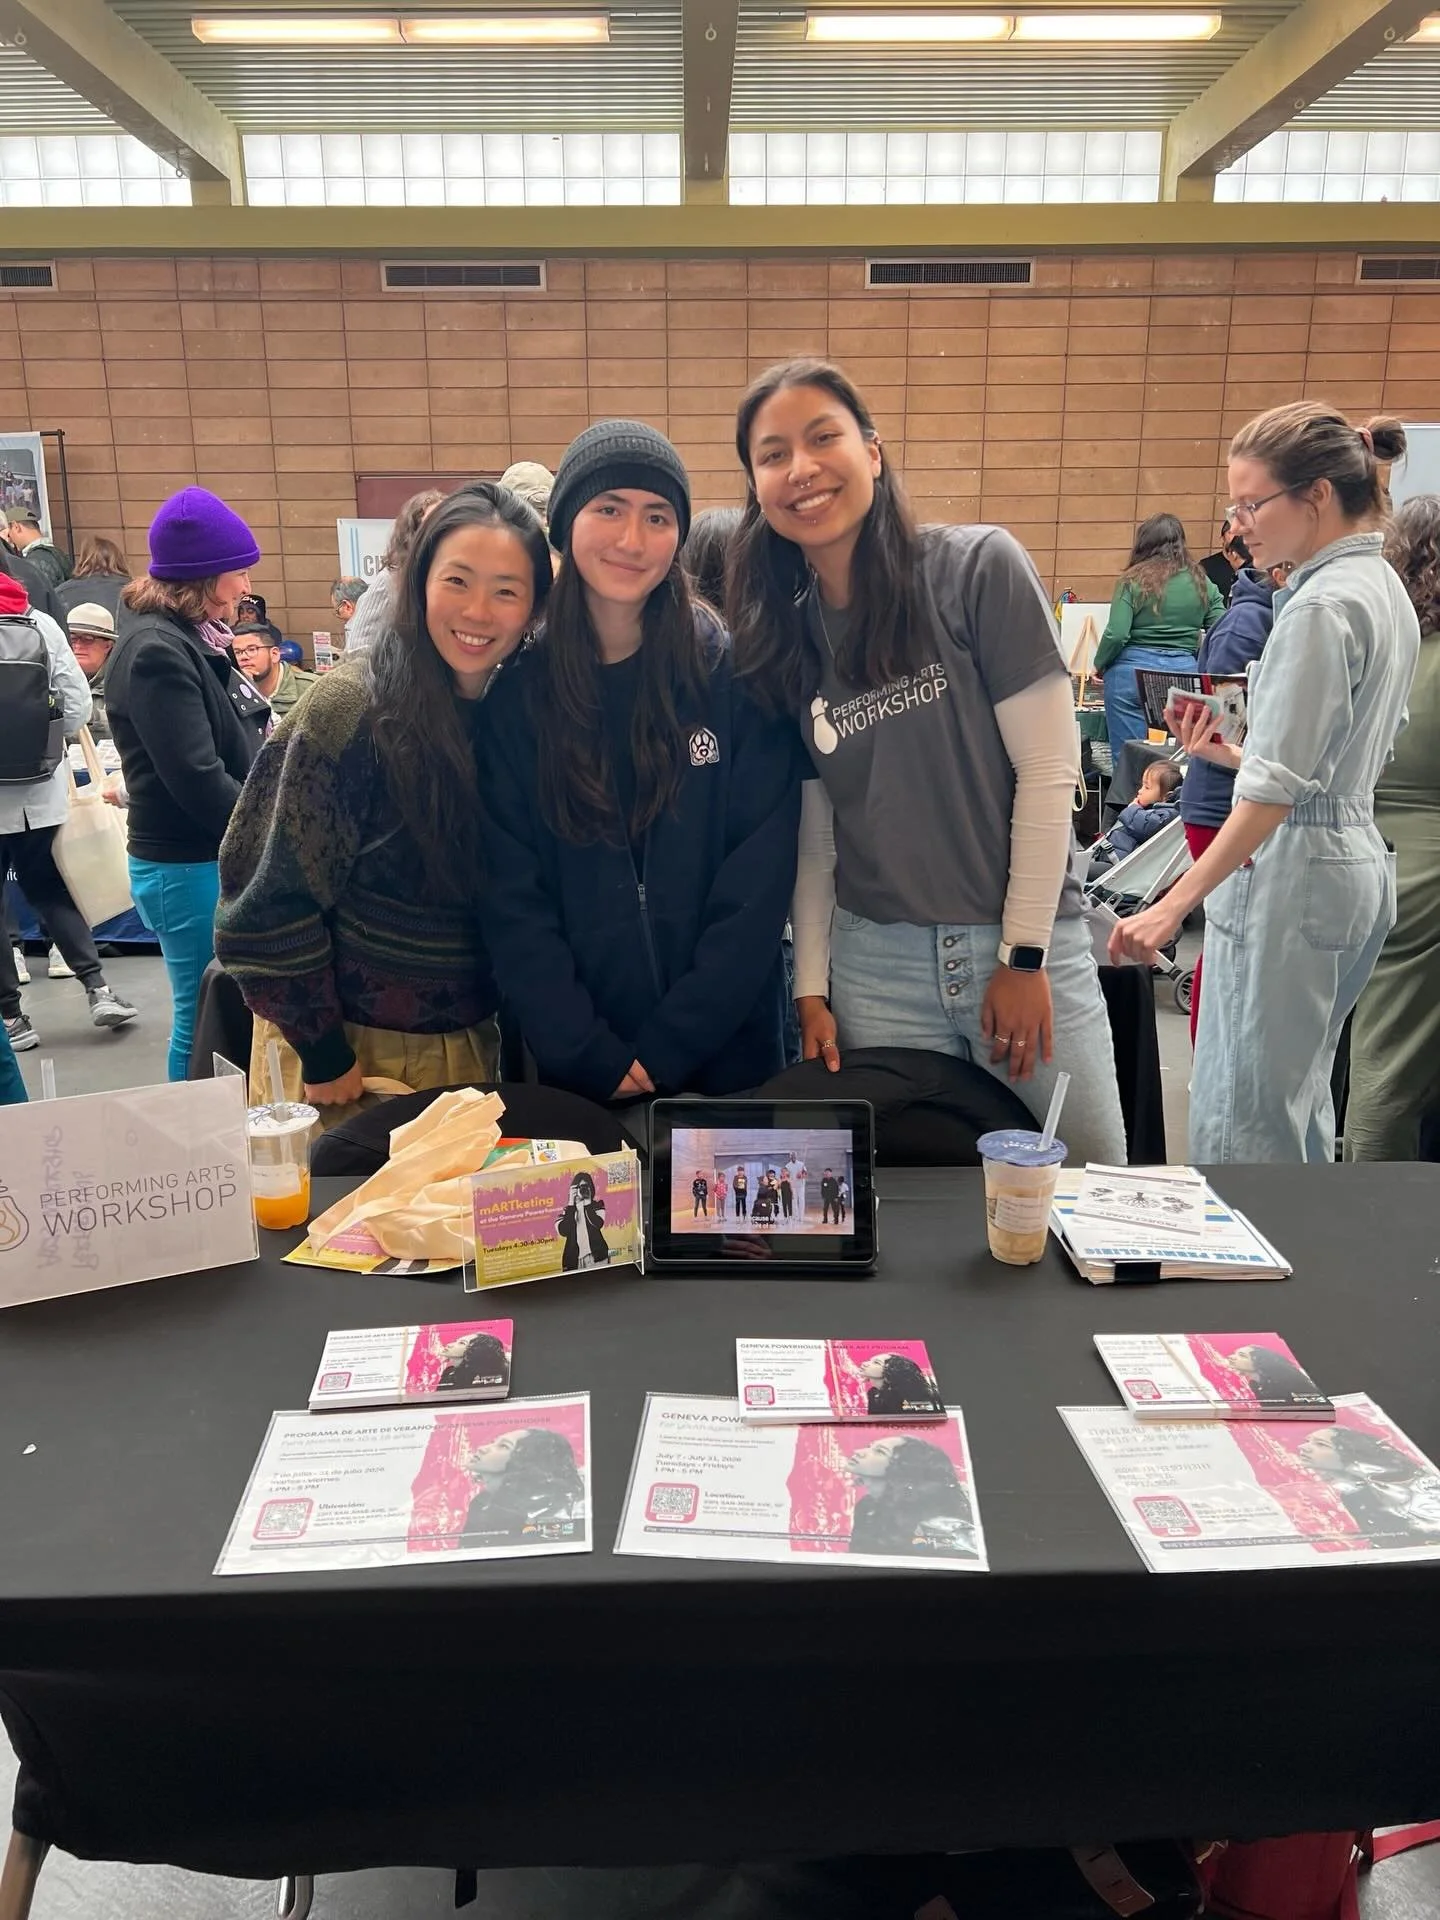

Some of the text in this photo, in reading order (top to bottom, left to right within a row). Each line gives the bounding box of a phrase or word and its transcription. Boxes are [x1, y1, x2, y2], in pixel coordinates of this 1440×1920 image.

[832, 663, 945, 720] PERFORMING ARTS
[836, 678, 948, 739] WORKSHOP
[40, 1164, 236, 1210] PERFORMING ARTS
[43, 1183, 237, 1236] WORKSHOP
[479, 1197, 554, 1216] mARTketing
[488, 1215, 499, 1223] the
[499, 1212, 524, 1221] Geneva
[483, 1243, 512, 1254] Tuesdays
[1084, 1247, 1267, 1263] WORK PERMIT CLINIC
[661, 1412, 709, 1422] GENEVA
[711, 1415, 748, 1424] POWE
[284, 1430, 339, 1438] PROGRAMA
[393, 1424, 432, 1432] VERANO
